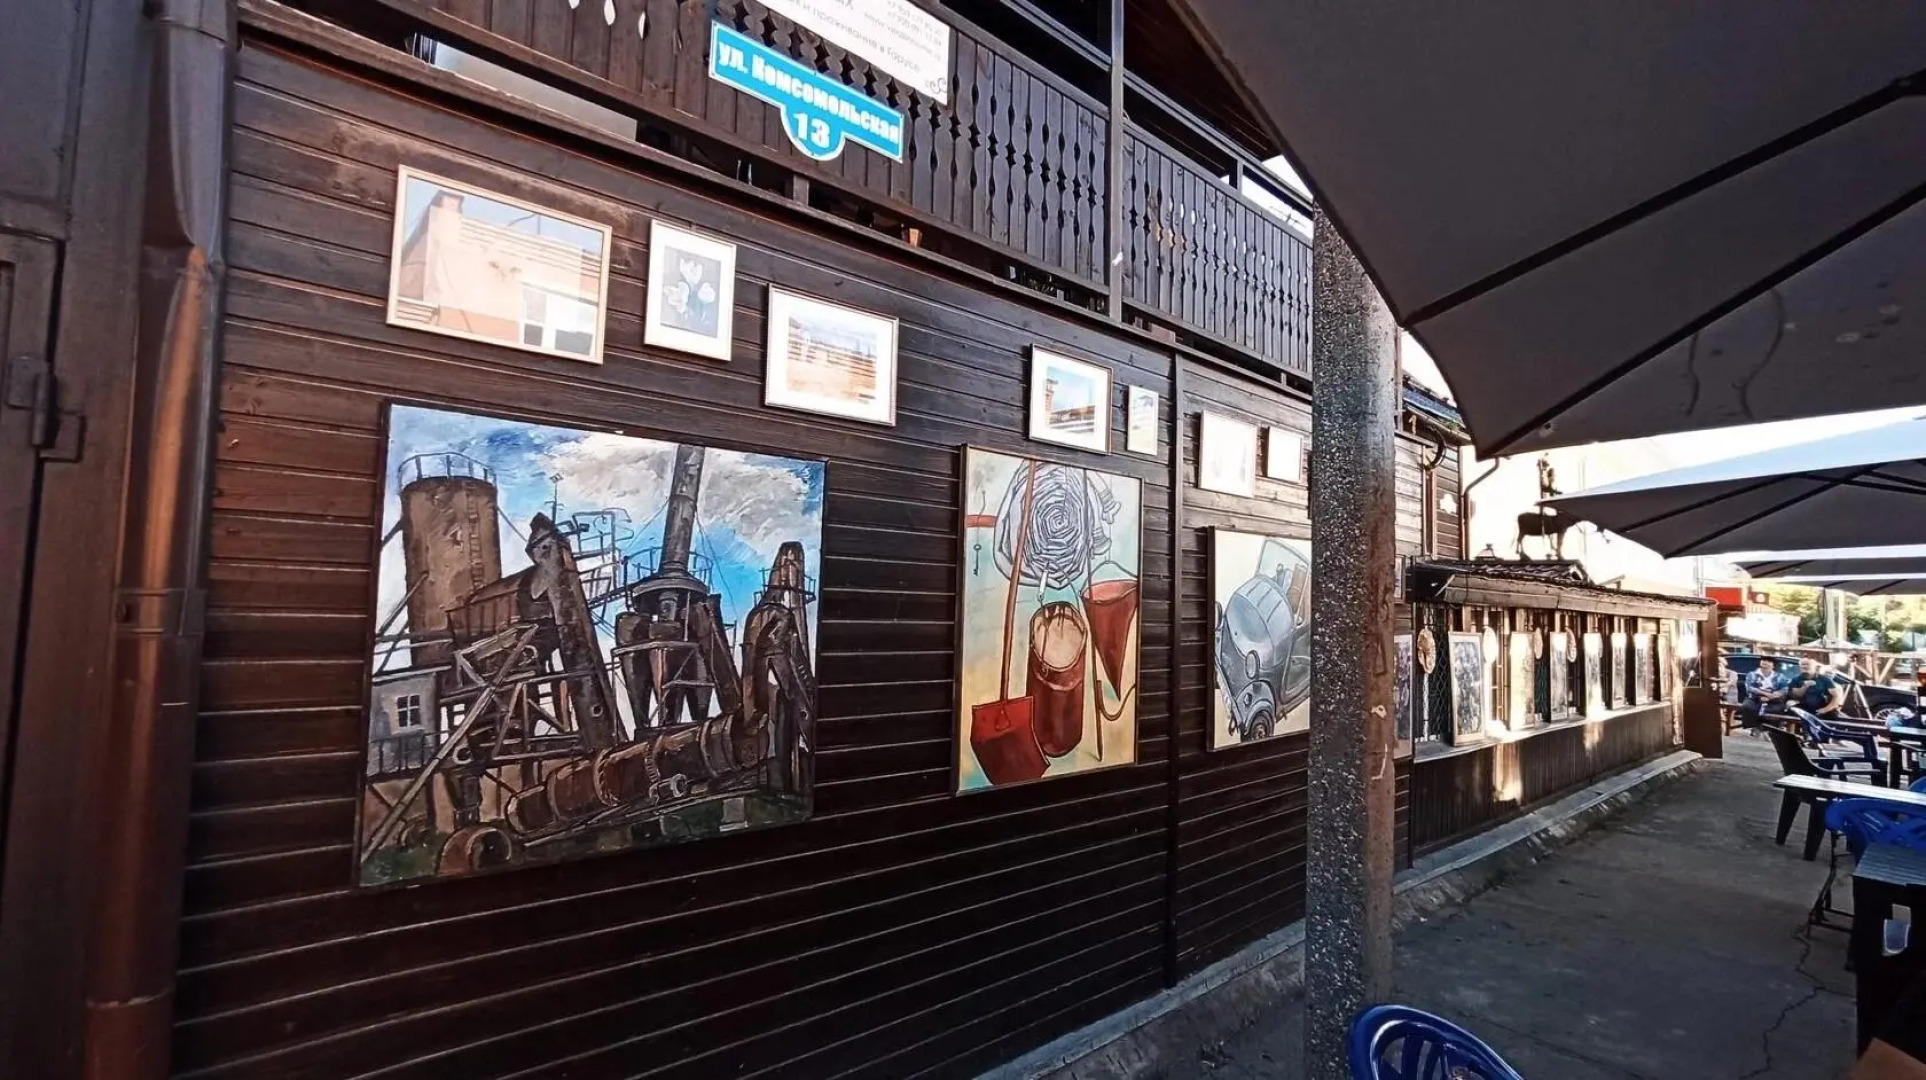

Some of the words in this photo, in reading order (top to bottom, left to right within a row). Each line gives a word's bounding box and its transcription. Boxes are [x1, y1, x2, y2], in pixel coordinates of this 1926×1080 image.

[718, 41, 749, 74] ул.
[751, 56, 900, 144] Комсомольская
[793, 112, 831, 149] 13
